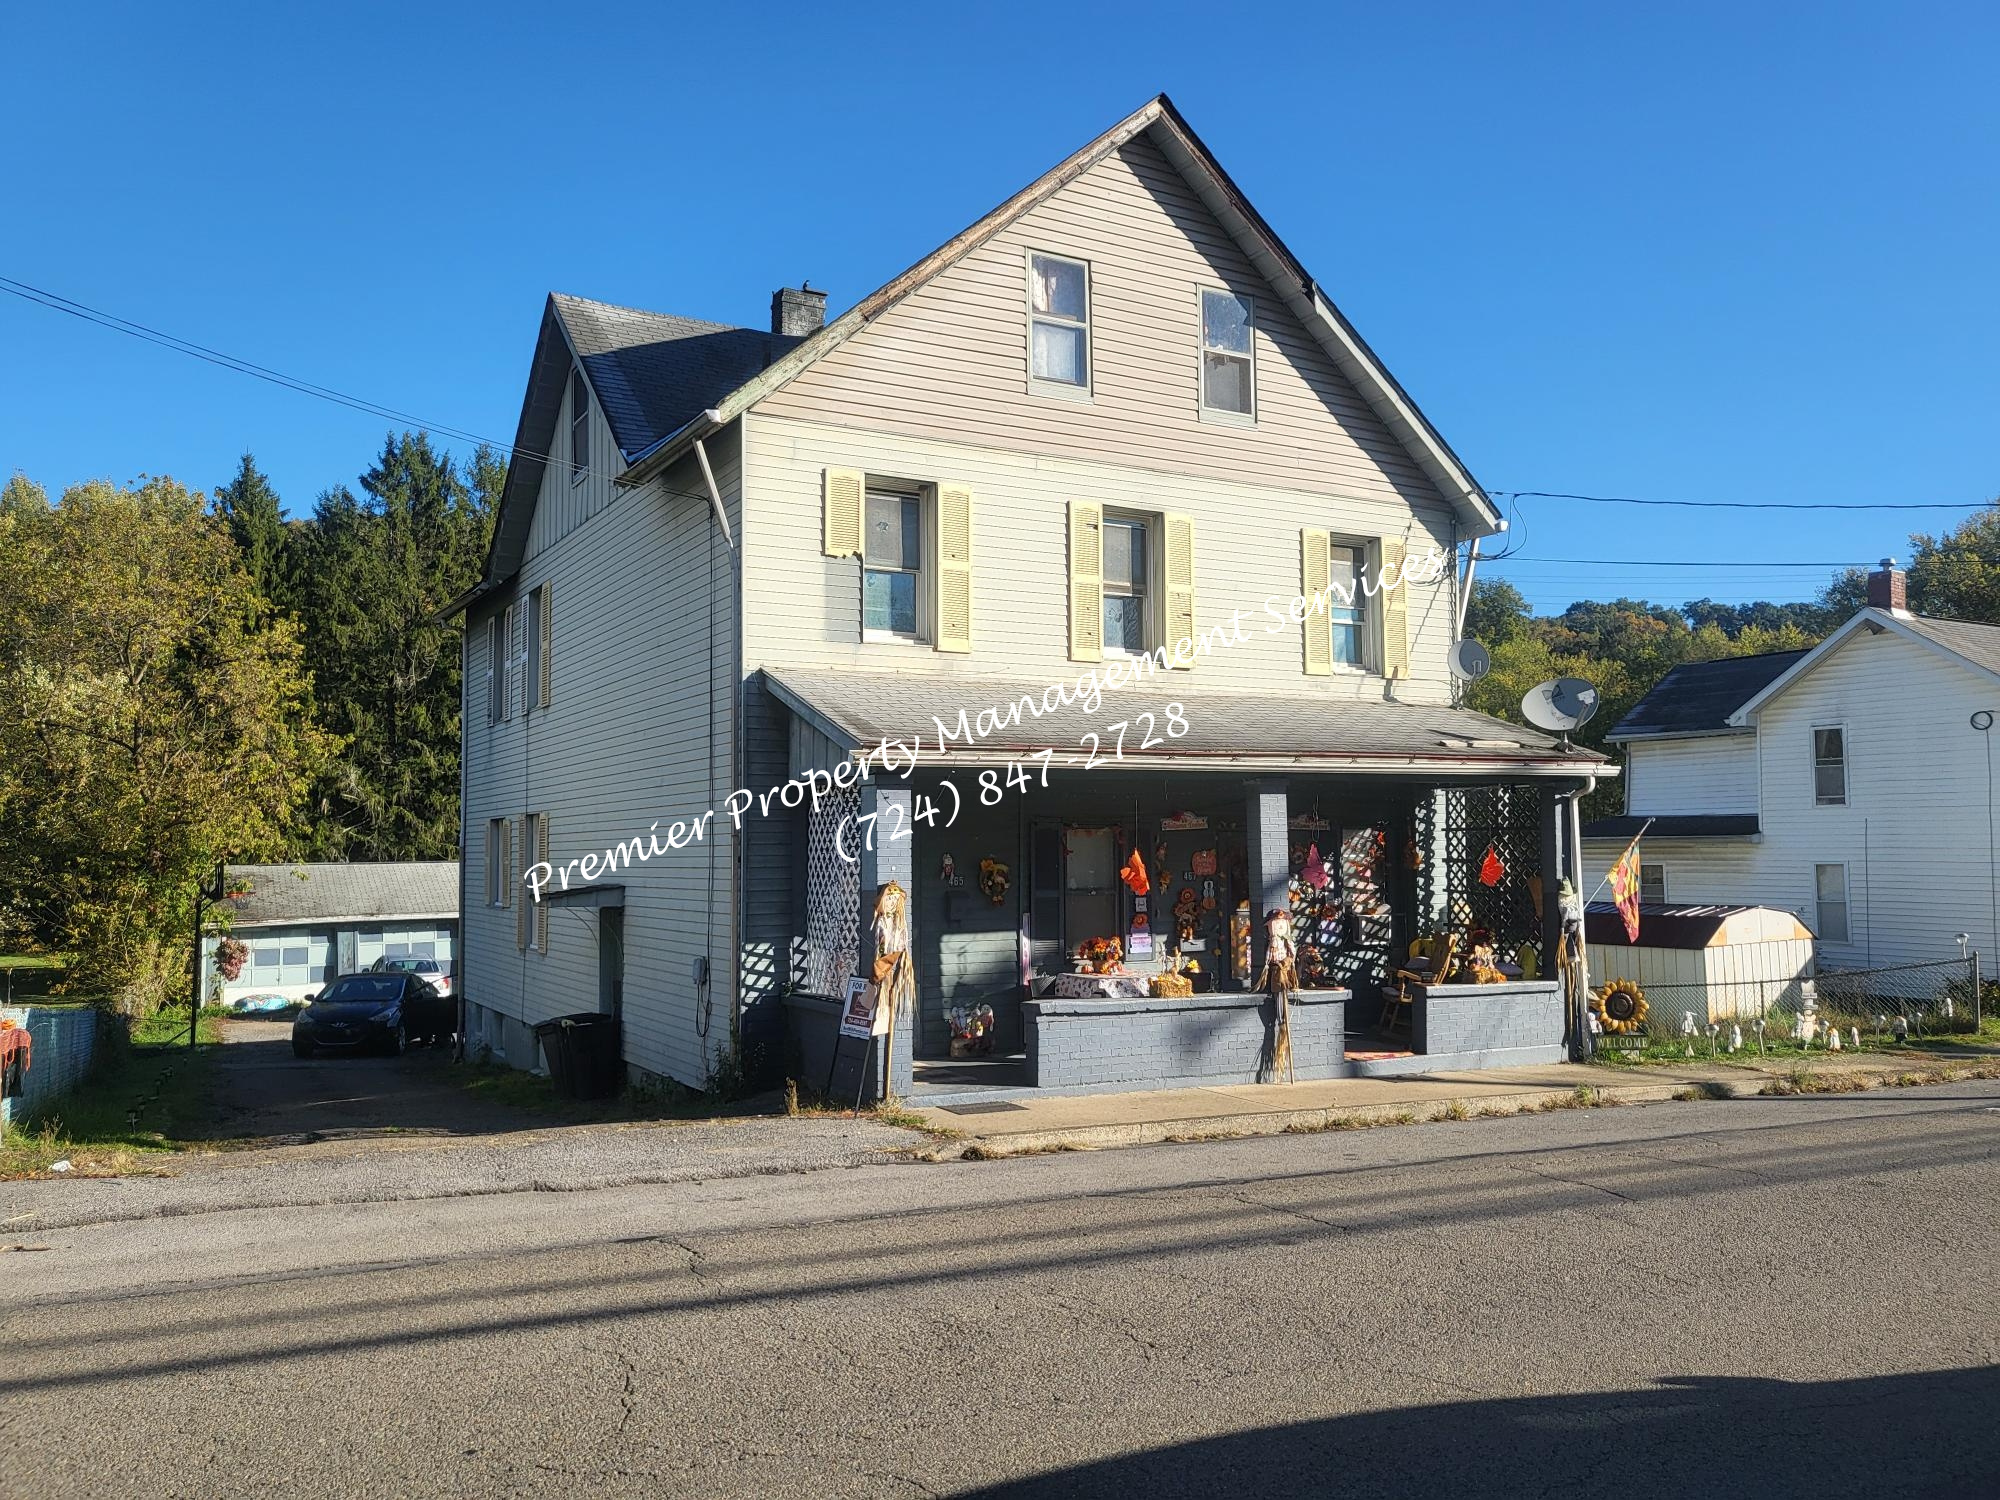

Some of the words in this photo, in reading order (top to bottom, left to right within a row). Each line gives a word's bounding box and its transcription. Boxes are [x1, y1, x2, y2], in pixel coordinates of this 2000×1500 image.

[948, 876, 965, 887] 465
[852, 982, 863, 991] FOR
[1597, 1037, 1648, 1048] WELCOME
